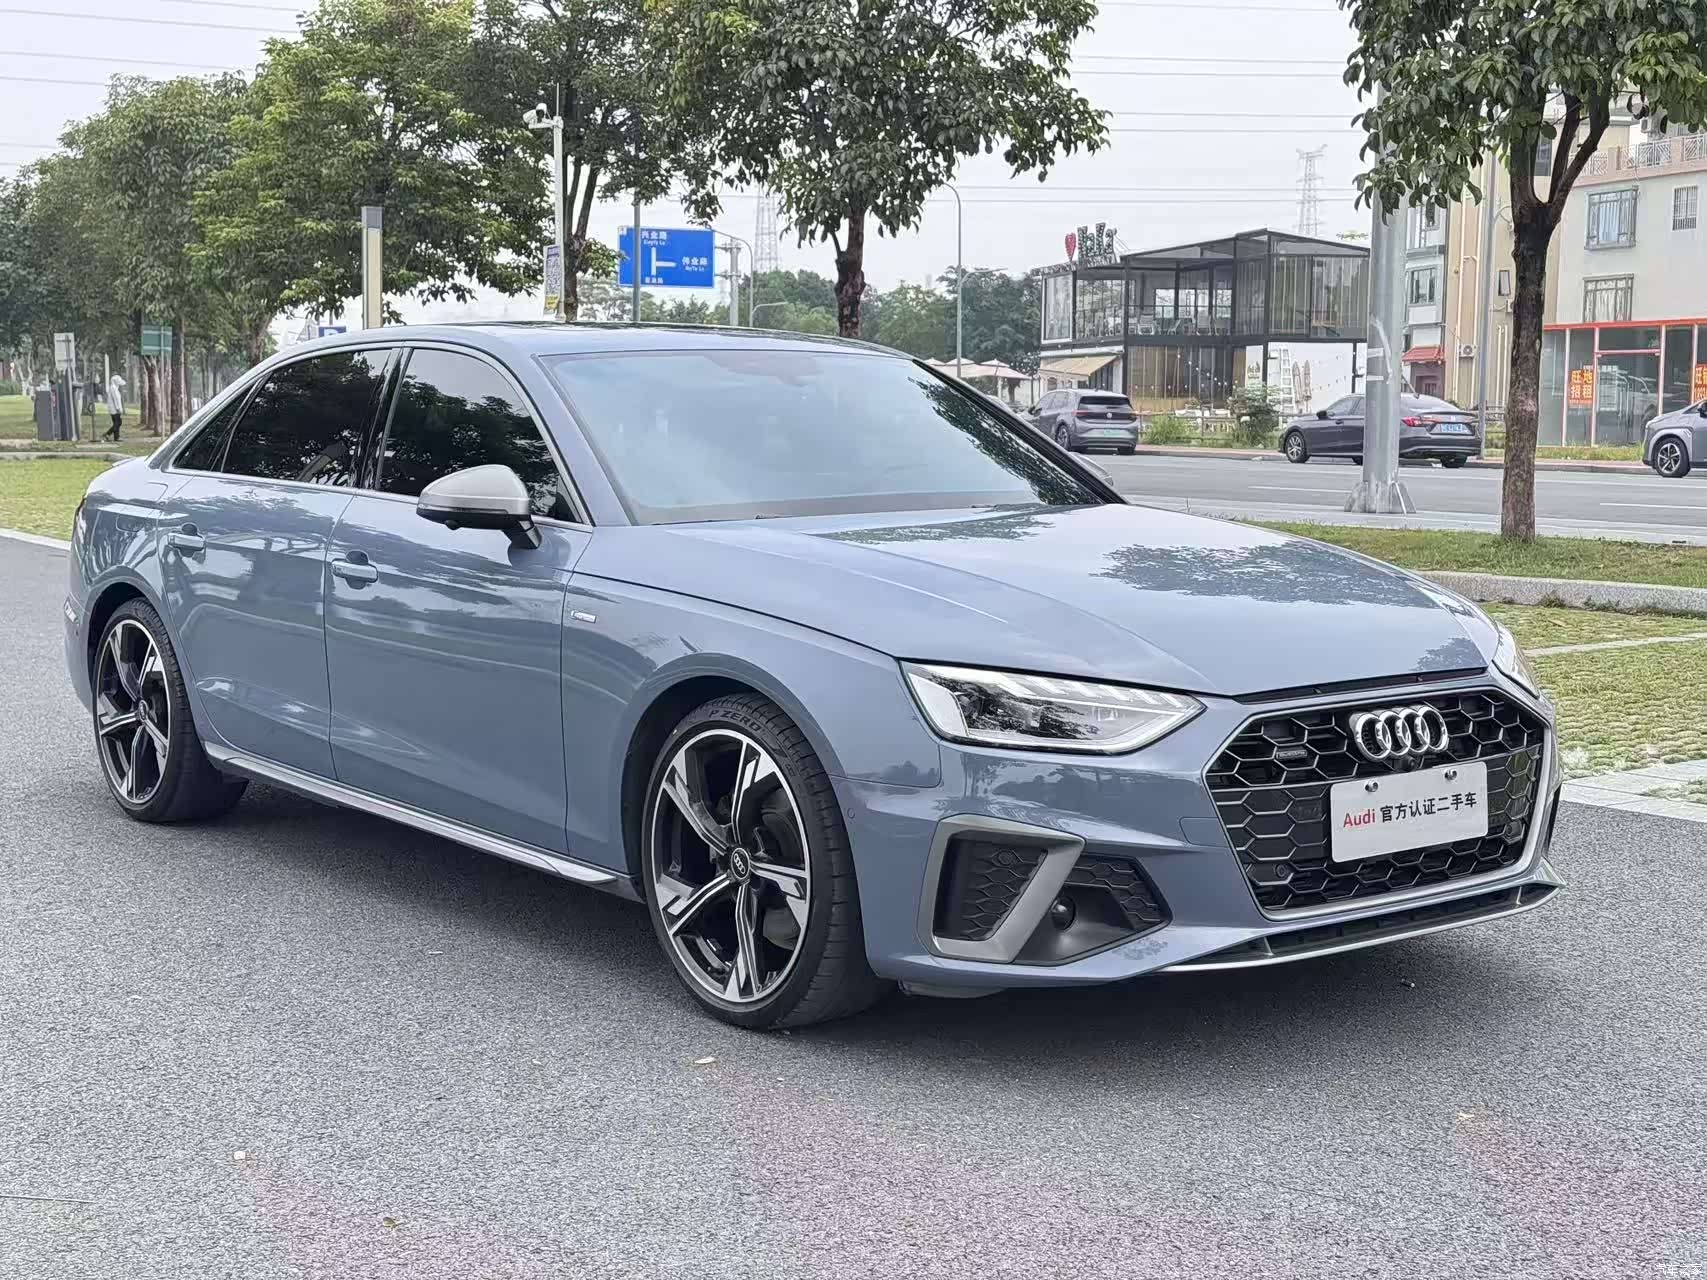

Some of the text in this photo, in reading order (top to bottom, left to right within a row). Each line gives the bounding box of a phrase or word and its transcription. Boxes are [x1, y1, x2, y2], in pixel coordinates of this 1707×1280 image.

[1570, 384, 1592, 399] 招租
[720, 710, 762, 732] ZERO
[1343, 792, 1477, 828] Audi 官方认证二手车
